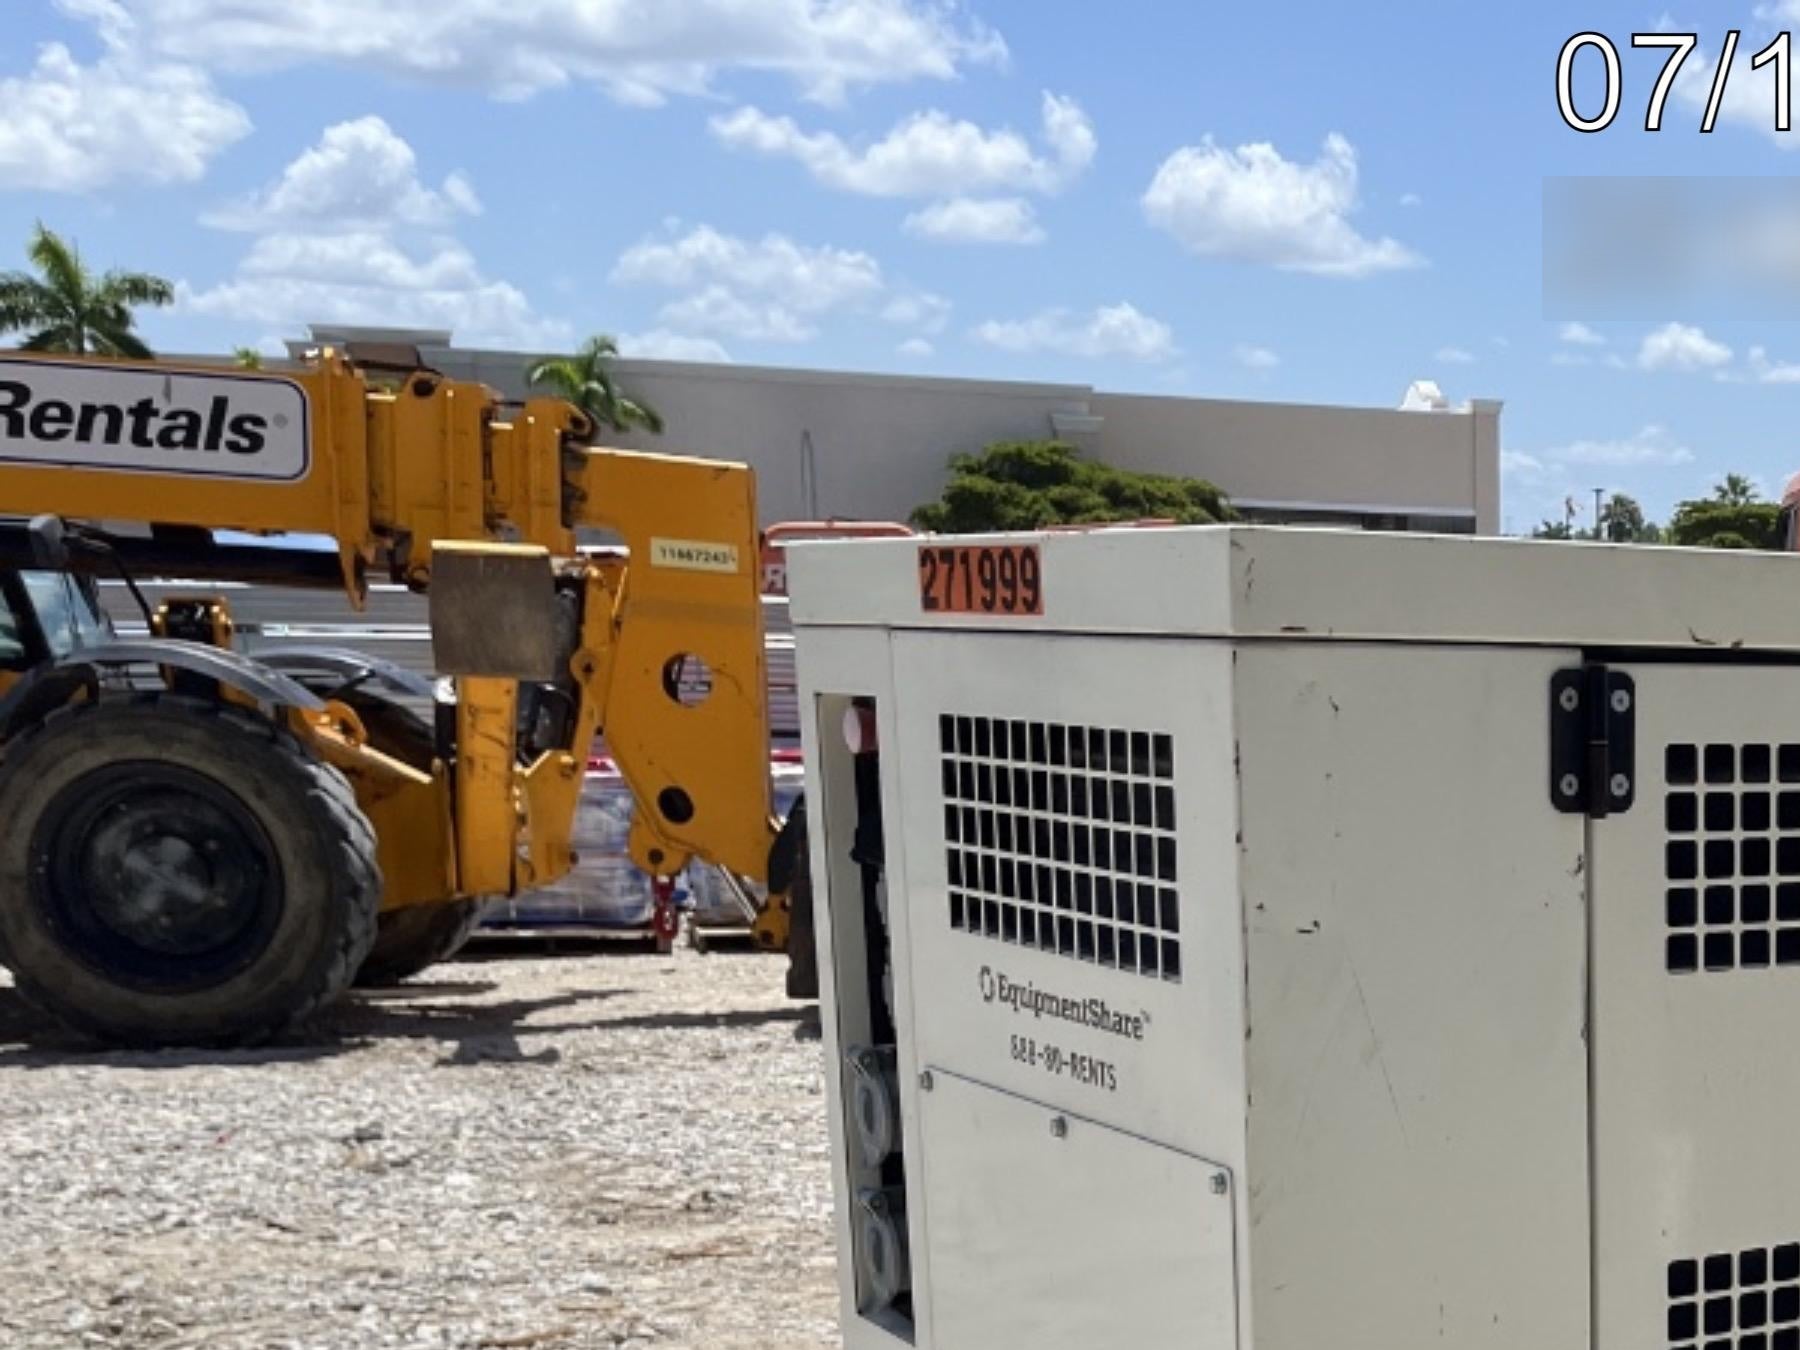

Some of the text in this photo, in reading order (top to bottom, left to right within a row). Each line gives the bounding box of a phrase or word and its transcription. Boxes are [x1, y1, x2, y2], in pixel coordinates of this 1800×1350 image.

[0, 380, 268, 455] Rentals
[920, 547, 1040, 612] 271999
[997, 972, 1144, 1041] EquipmentShare
